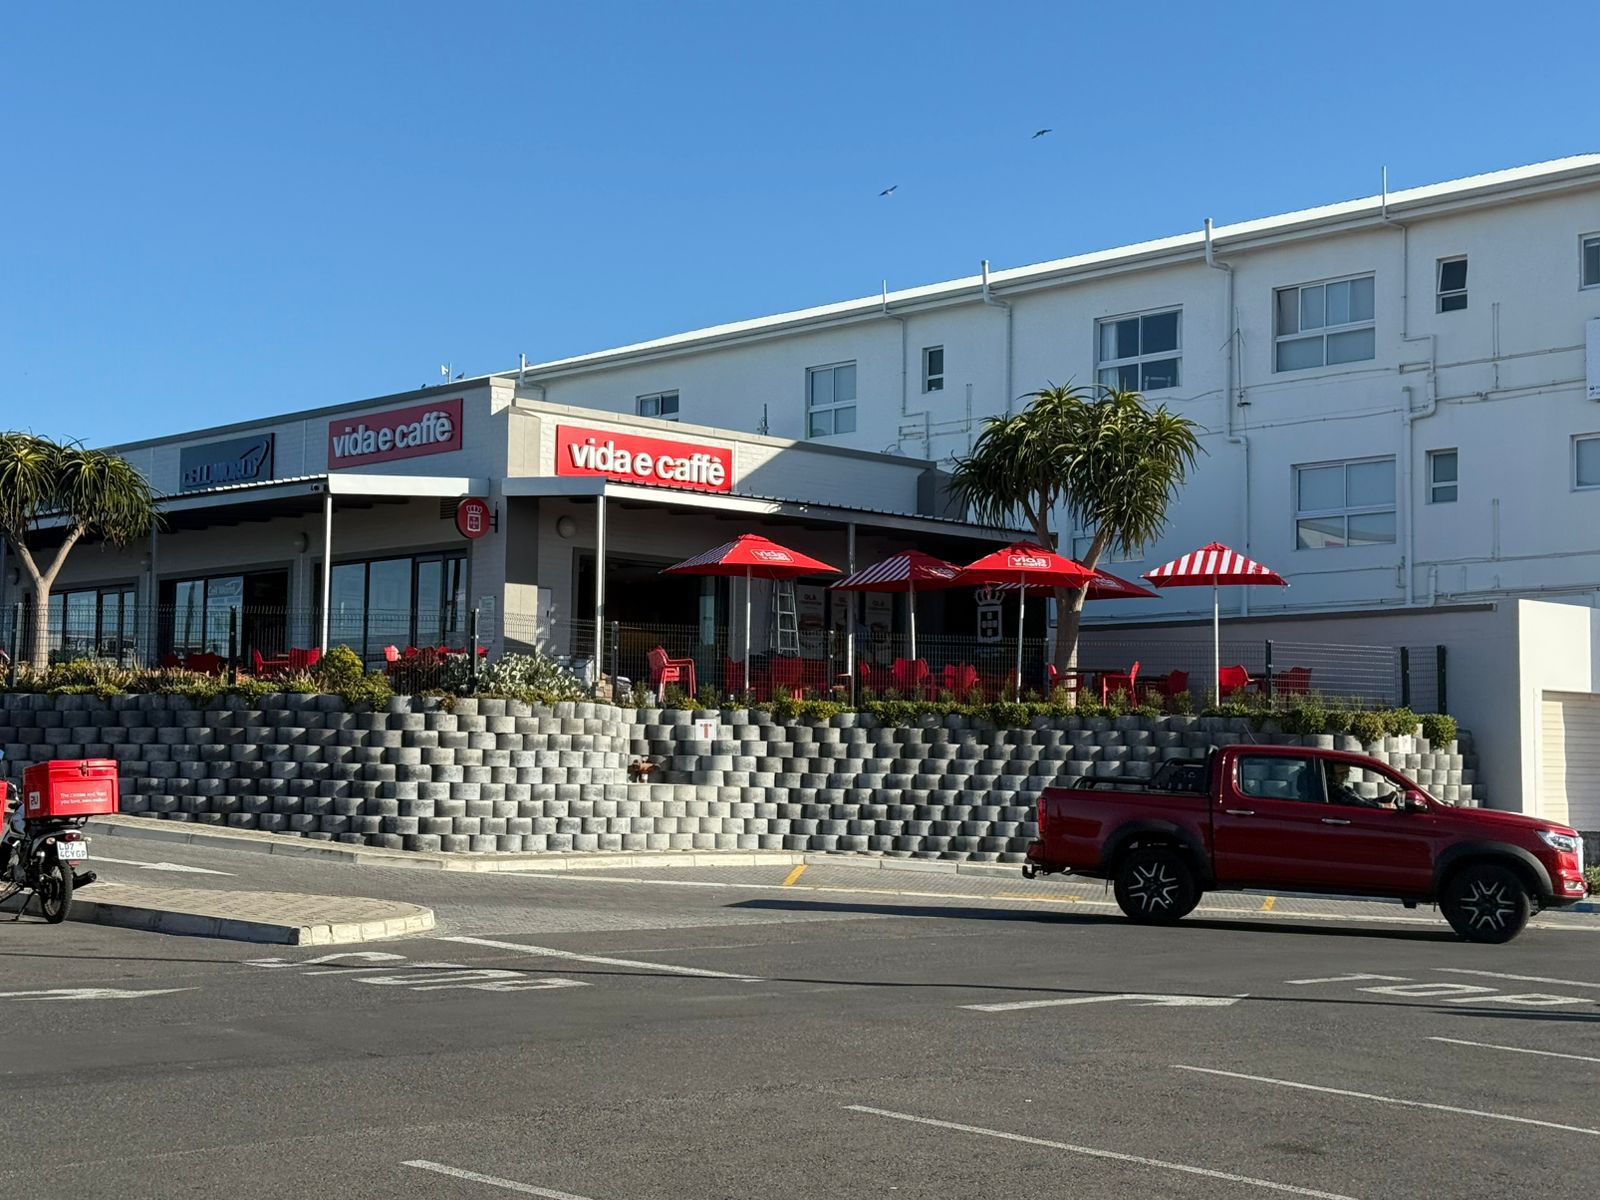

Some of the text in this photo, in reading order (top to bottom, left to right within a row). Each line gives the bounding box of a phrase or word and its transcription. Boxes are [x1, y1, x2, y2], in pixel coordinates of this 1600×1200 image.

[333, 411, 453, 458] vida e caffè
[569, 438, 725, 486] vida e caffè
